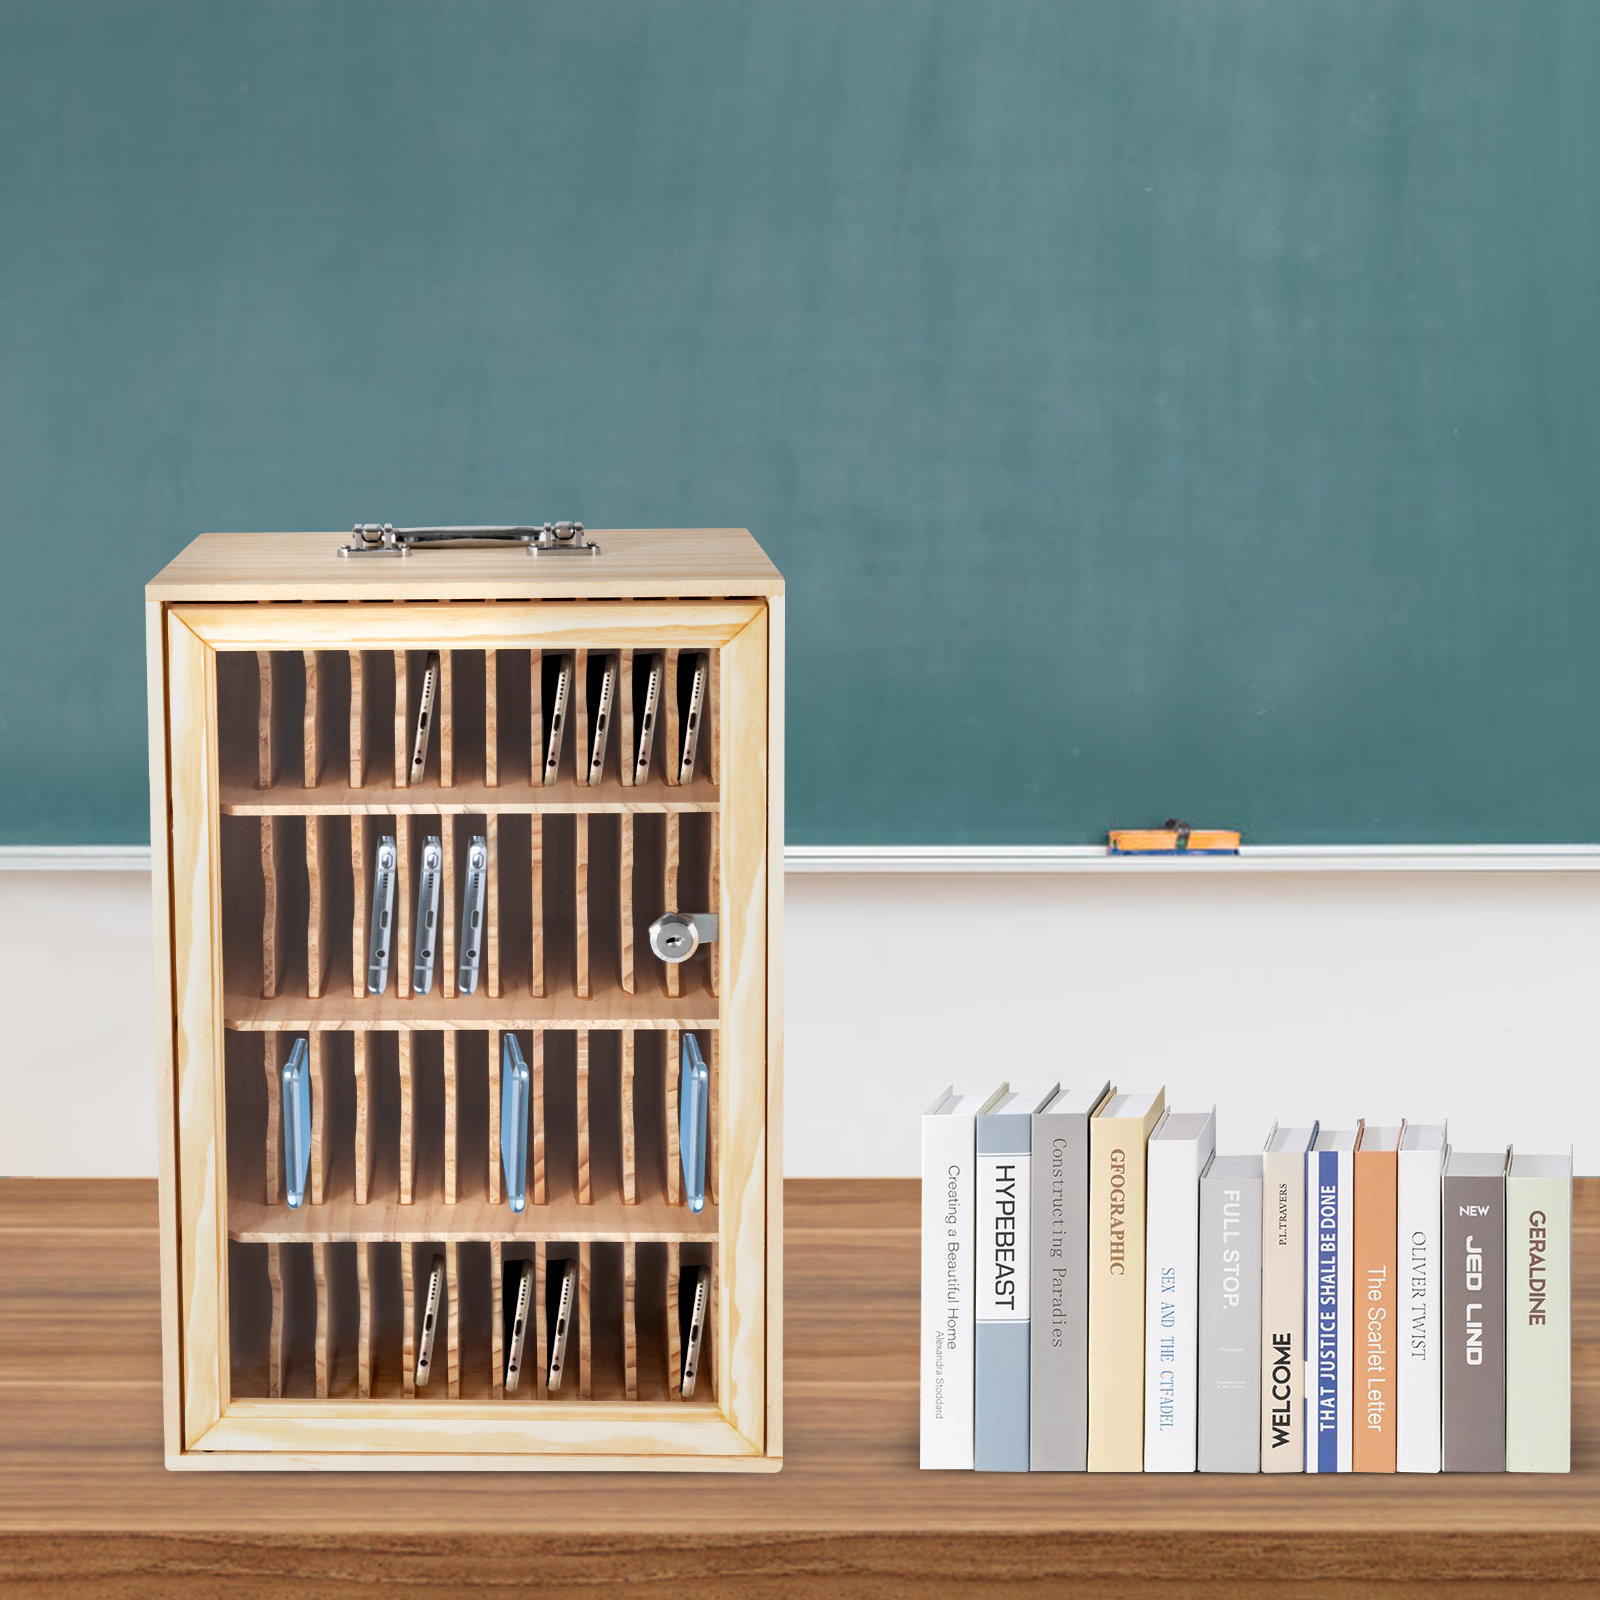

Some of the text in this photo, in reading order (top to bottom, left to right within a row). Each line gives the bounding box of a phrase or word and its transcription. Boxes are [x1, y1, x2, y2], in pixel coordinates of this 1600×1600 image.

[945, 1165, 961, 1350] Creating a Beautiful Home
[994, 1164, 1016, 1311] HYPEBEAST
[1049, 1137, 1068, 1348] Constructing Paradies
[1222, 1189, 1240, 1310] FULL STOP.
[1459, 1205, 1490, 1217] NEW
[1528, 1210, 1546, 1326] GERALDINE
[1160, 1267, 1176, 1294] SEX
[1160, 1301, 1176, 1328] AND
[1320, 1185, 1336, 1432] THAT JUSTICE SHALL BE DONE
[1410, 1231, 1427, 1361] OLIVER TWIST
[1465, 1235, 1483, 1366] JED LIND
[935, 1330, 945, 1419] Alexandra Stoddard
[1160, 1336, 1175, 1362] THE
[1271, 1333, 1291, 1449] WELCOME
[1367, 1265, 1387, 1432] The Scarlet Letter
